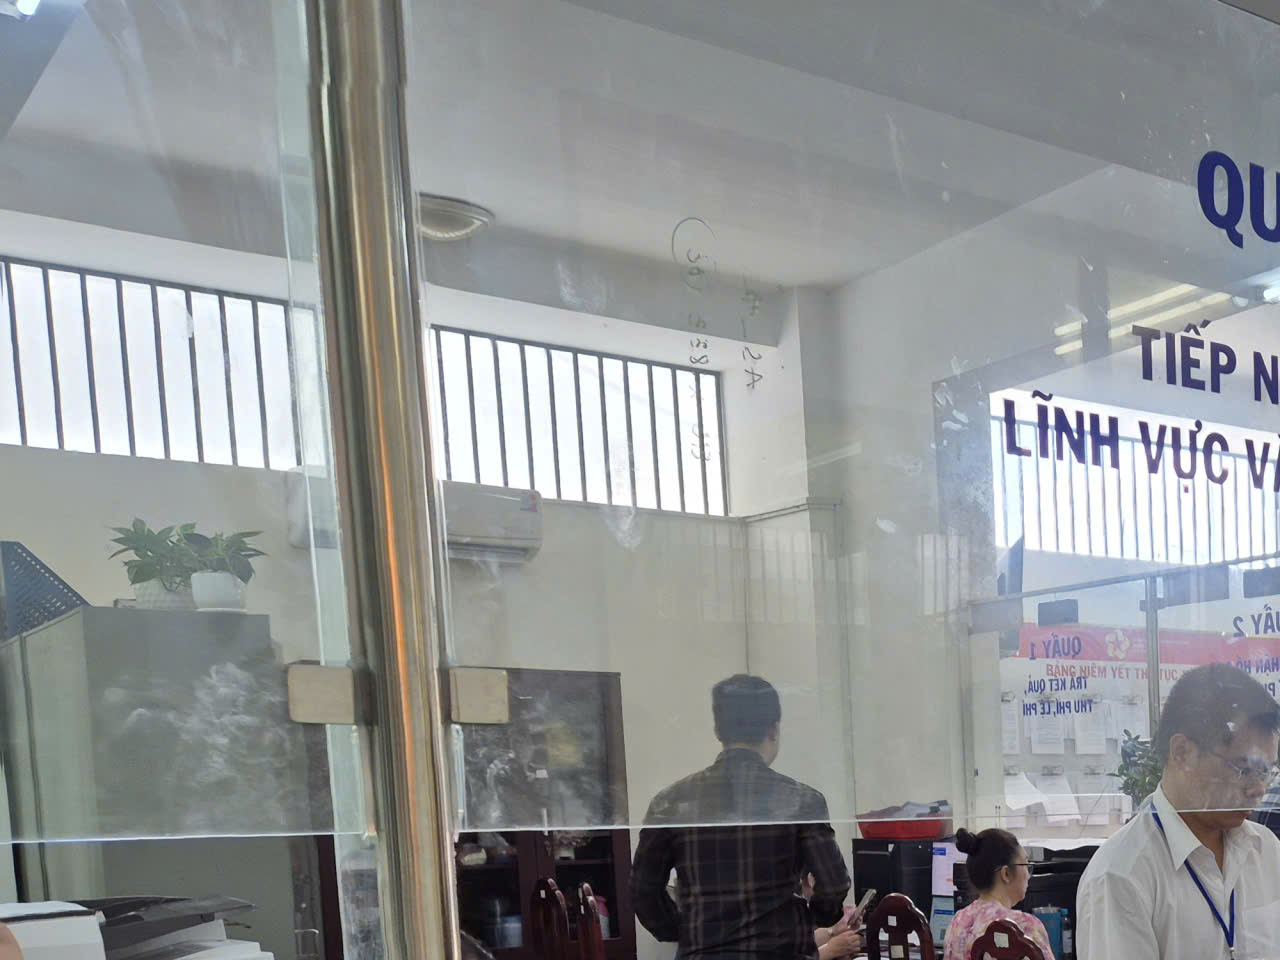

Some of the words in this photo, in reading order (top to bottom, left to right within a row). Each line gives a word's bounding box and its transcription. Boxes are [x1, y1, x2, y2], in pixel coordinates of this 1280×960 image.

[1132, 320, 1237, 393] TIẾP
[1002, 391, 1120, 468] LĨNH
[1138, 420, 1230, 495] VỰC
